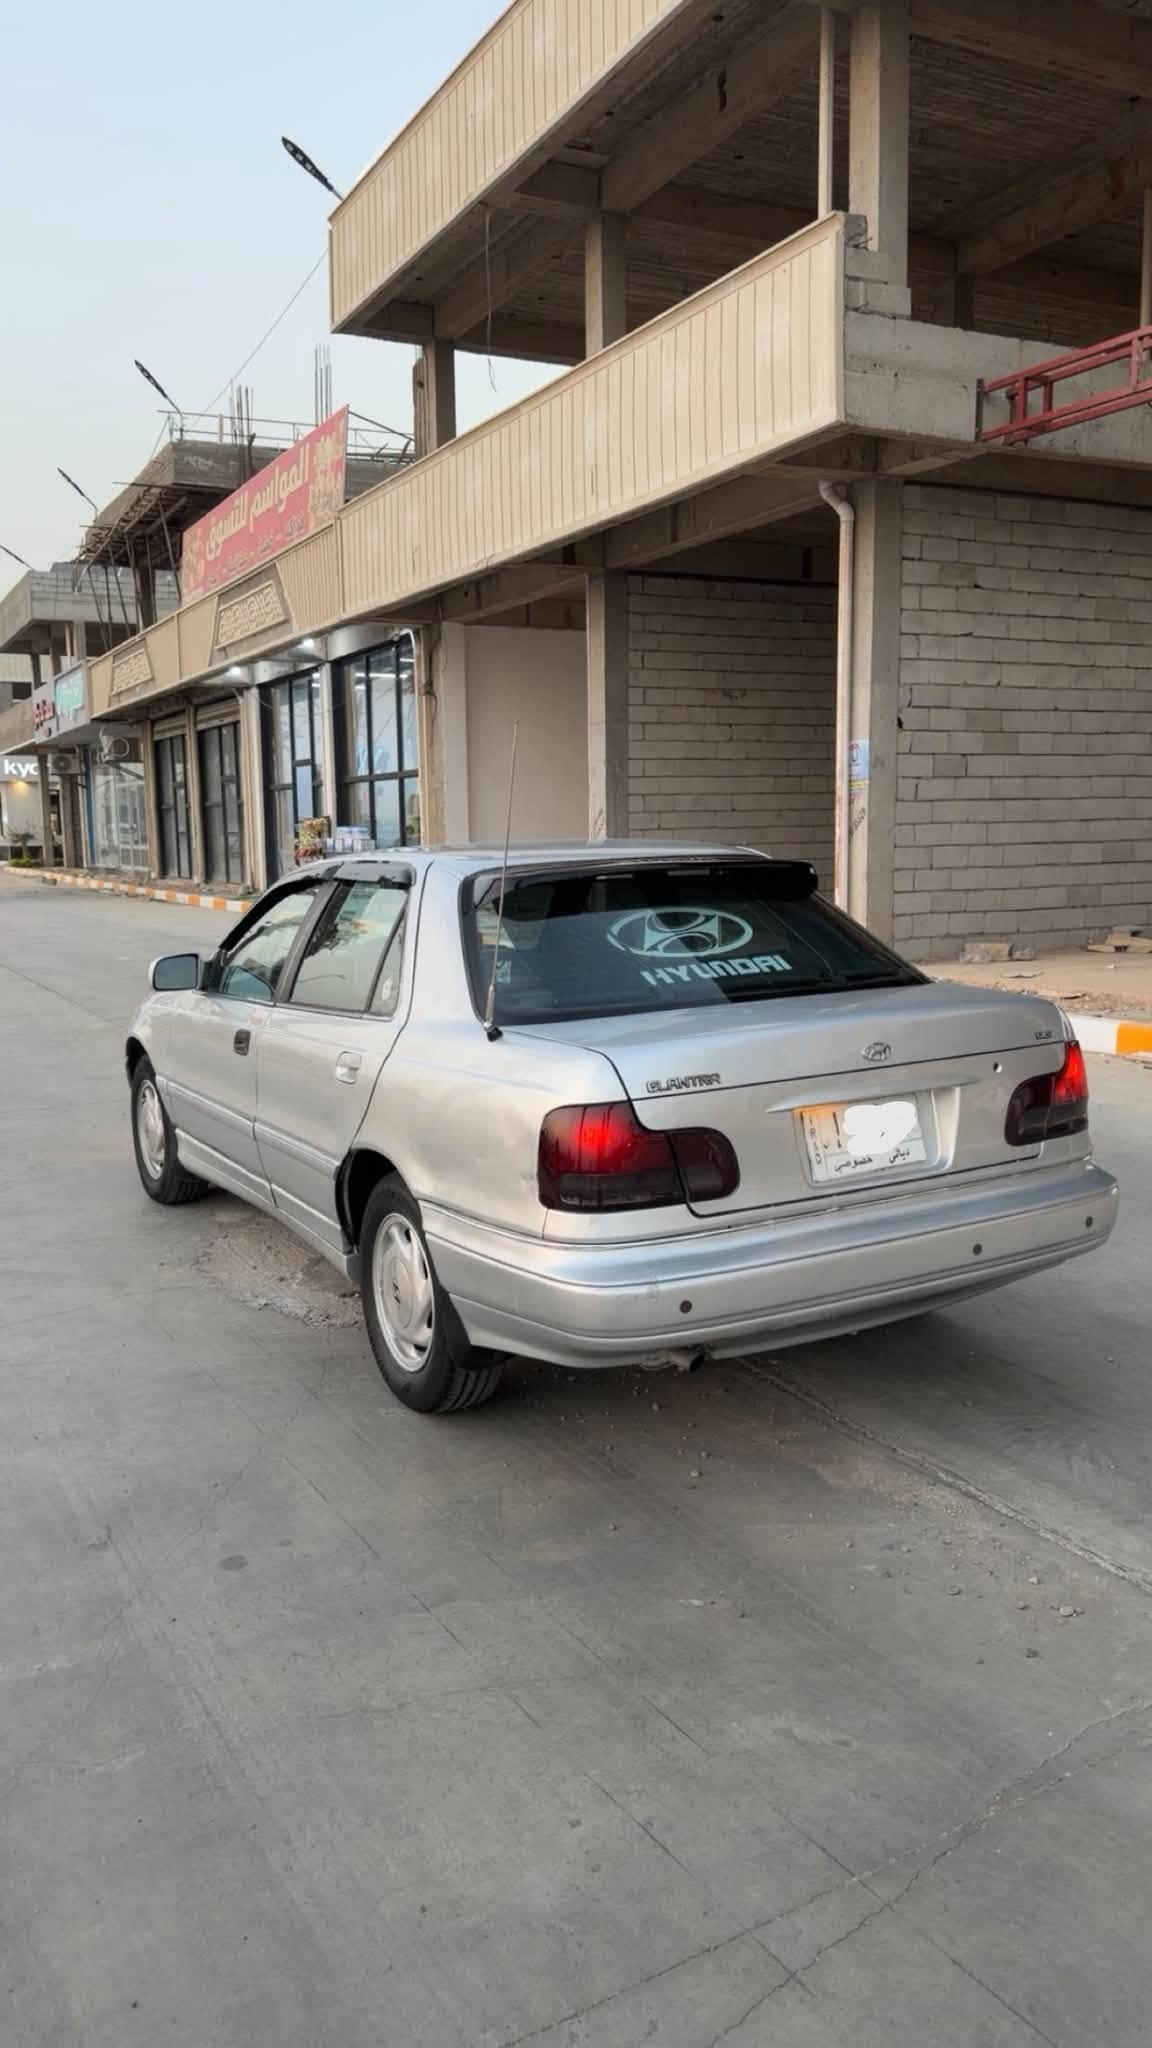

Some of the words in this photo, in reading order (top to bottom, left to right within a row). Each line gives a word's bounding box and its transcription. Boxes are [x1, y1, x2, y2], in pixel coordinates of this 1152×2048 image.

[249, 443, 310, 535] المواسم
[205, 490, 249, 562] للتسوق
[639, 954, 793, 986] HYUNDAI
[646, 1072, 721, 1093] ELANTRA
